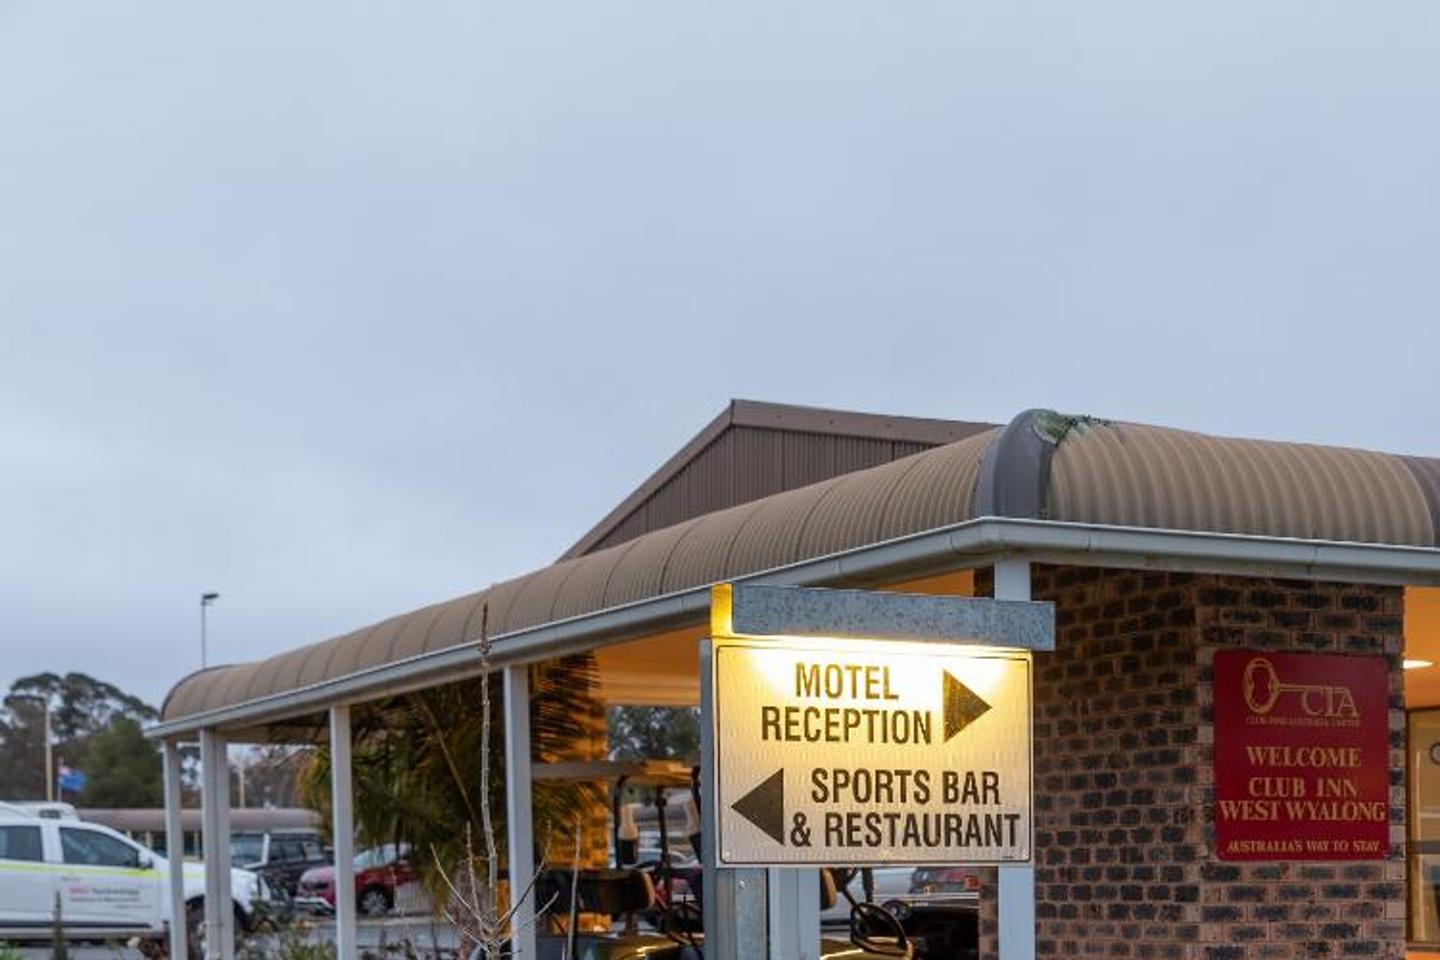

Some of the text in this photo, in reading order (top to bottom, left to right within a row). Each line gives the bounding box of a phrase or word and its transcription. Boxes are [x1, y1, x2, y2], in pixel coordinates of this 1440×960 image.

[795, 663, 899, 700] MOTEL
[761, 706, 932, 744] RECEPTION
[1247, 746, 1361, 767] WELCOME
[811, 768, 1001, 805] SPORTS BAR
[1249, 777, 1358, 797] CLUB INN
[1220, 800, 1386, 822] WEST WYALONG
[790, 813, 1020, 848] & RESTAURANT
[1306, 840, 1329, 852] WAY
[1333, 840, 1349, 851] TO
[1353, 840, 1379, 852] STAY
